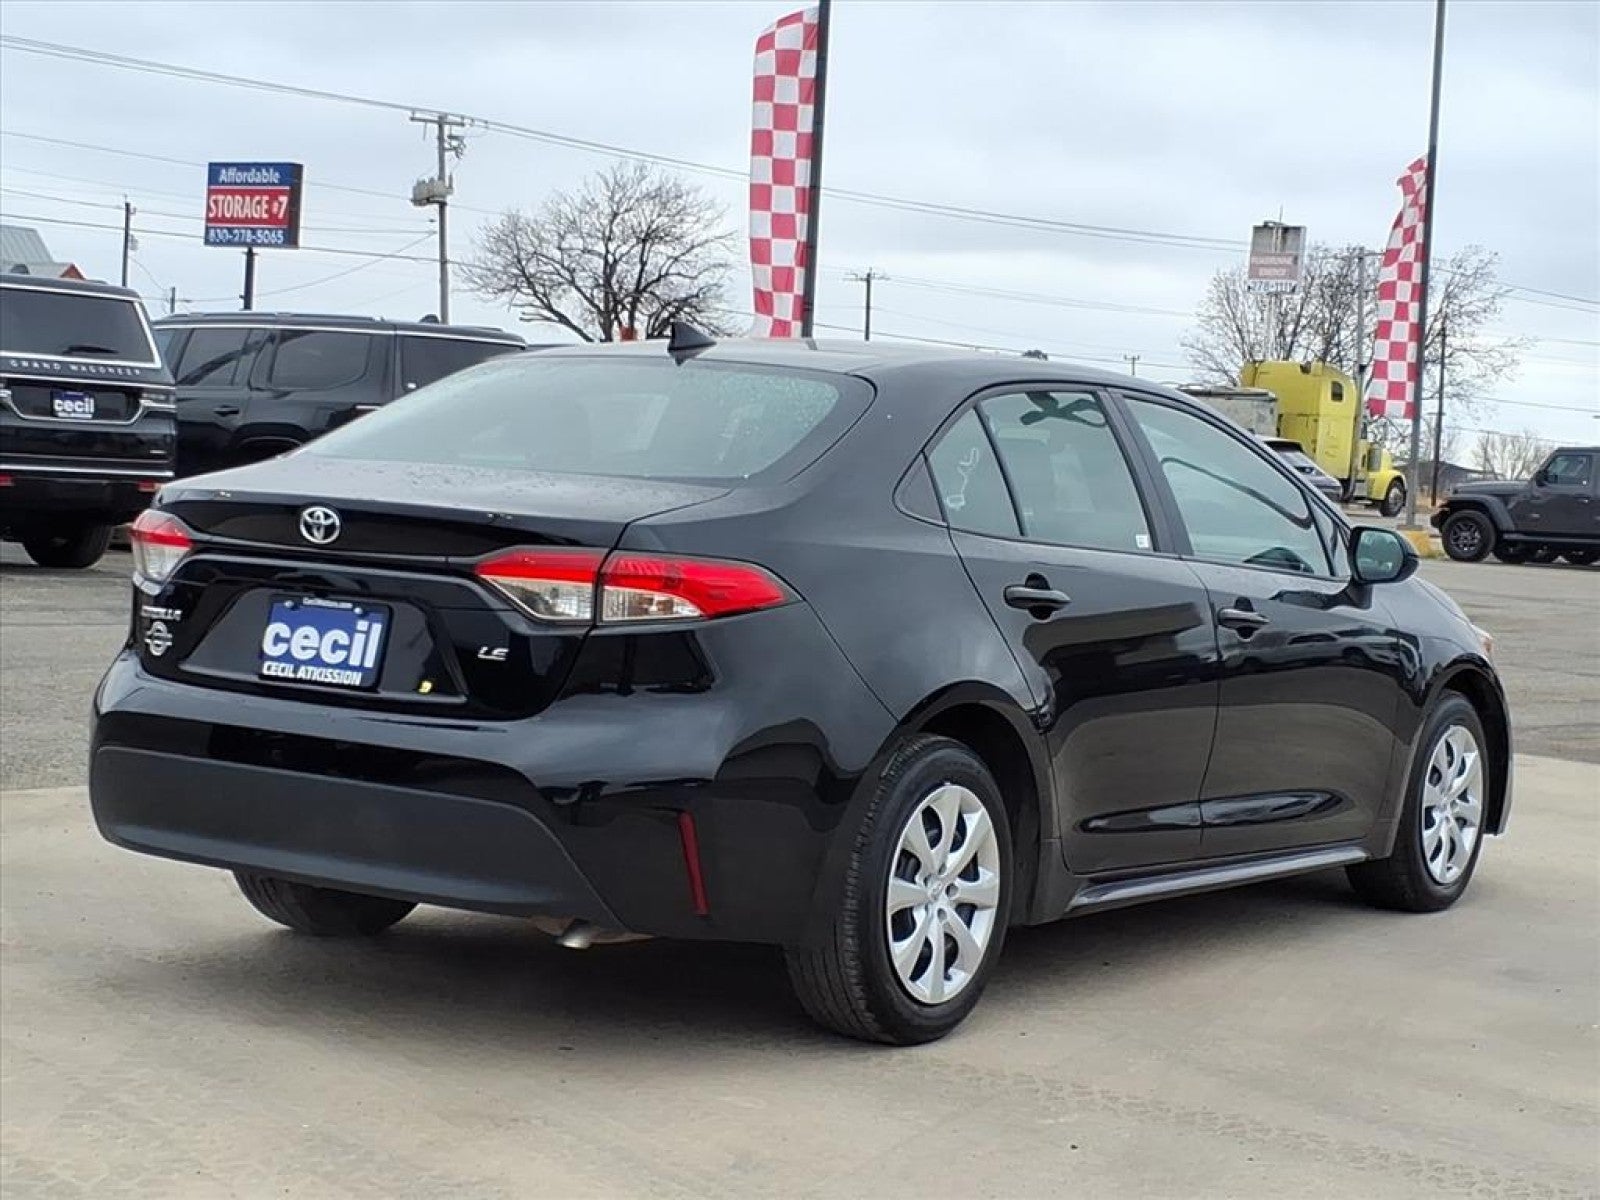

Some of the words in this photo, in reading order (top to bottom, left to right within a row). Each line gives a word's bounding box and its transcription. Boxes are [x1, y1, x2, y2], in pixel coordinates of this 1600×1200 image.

[219, 167, 280, 184] Affordable
[208, 195, 269, 219] STORAGE
[53, 396, 95, 414] cecil
[262, 619, 382, 668] cecil
[477, 646, 509, 661] LE
[262, 660, 295, 679] CECIL
[296, 664, 362, 687] ATKISSION
